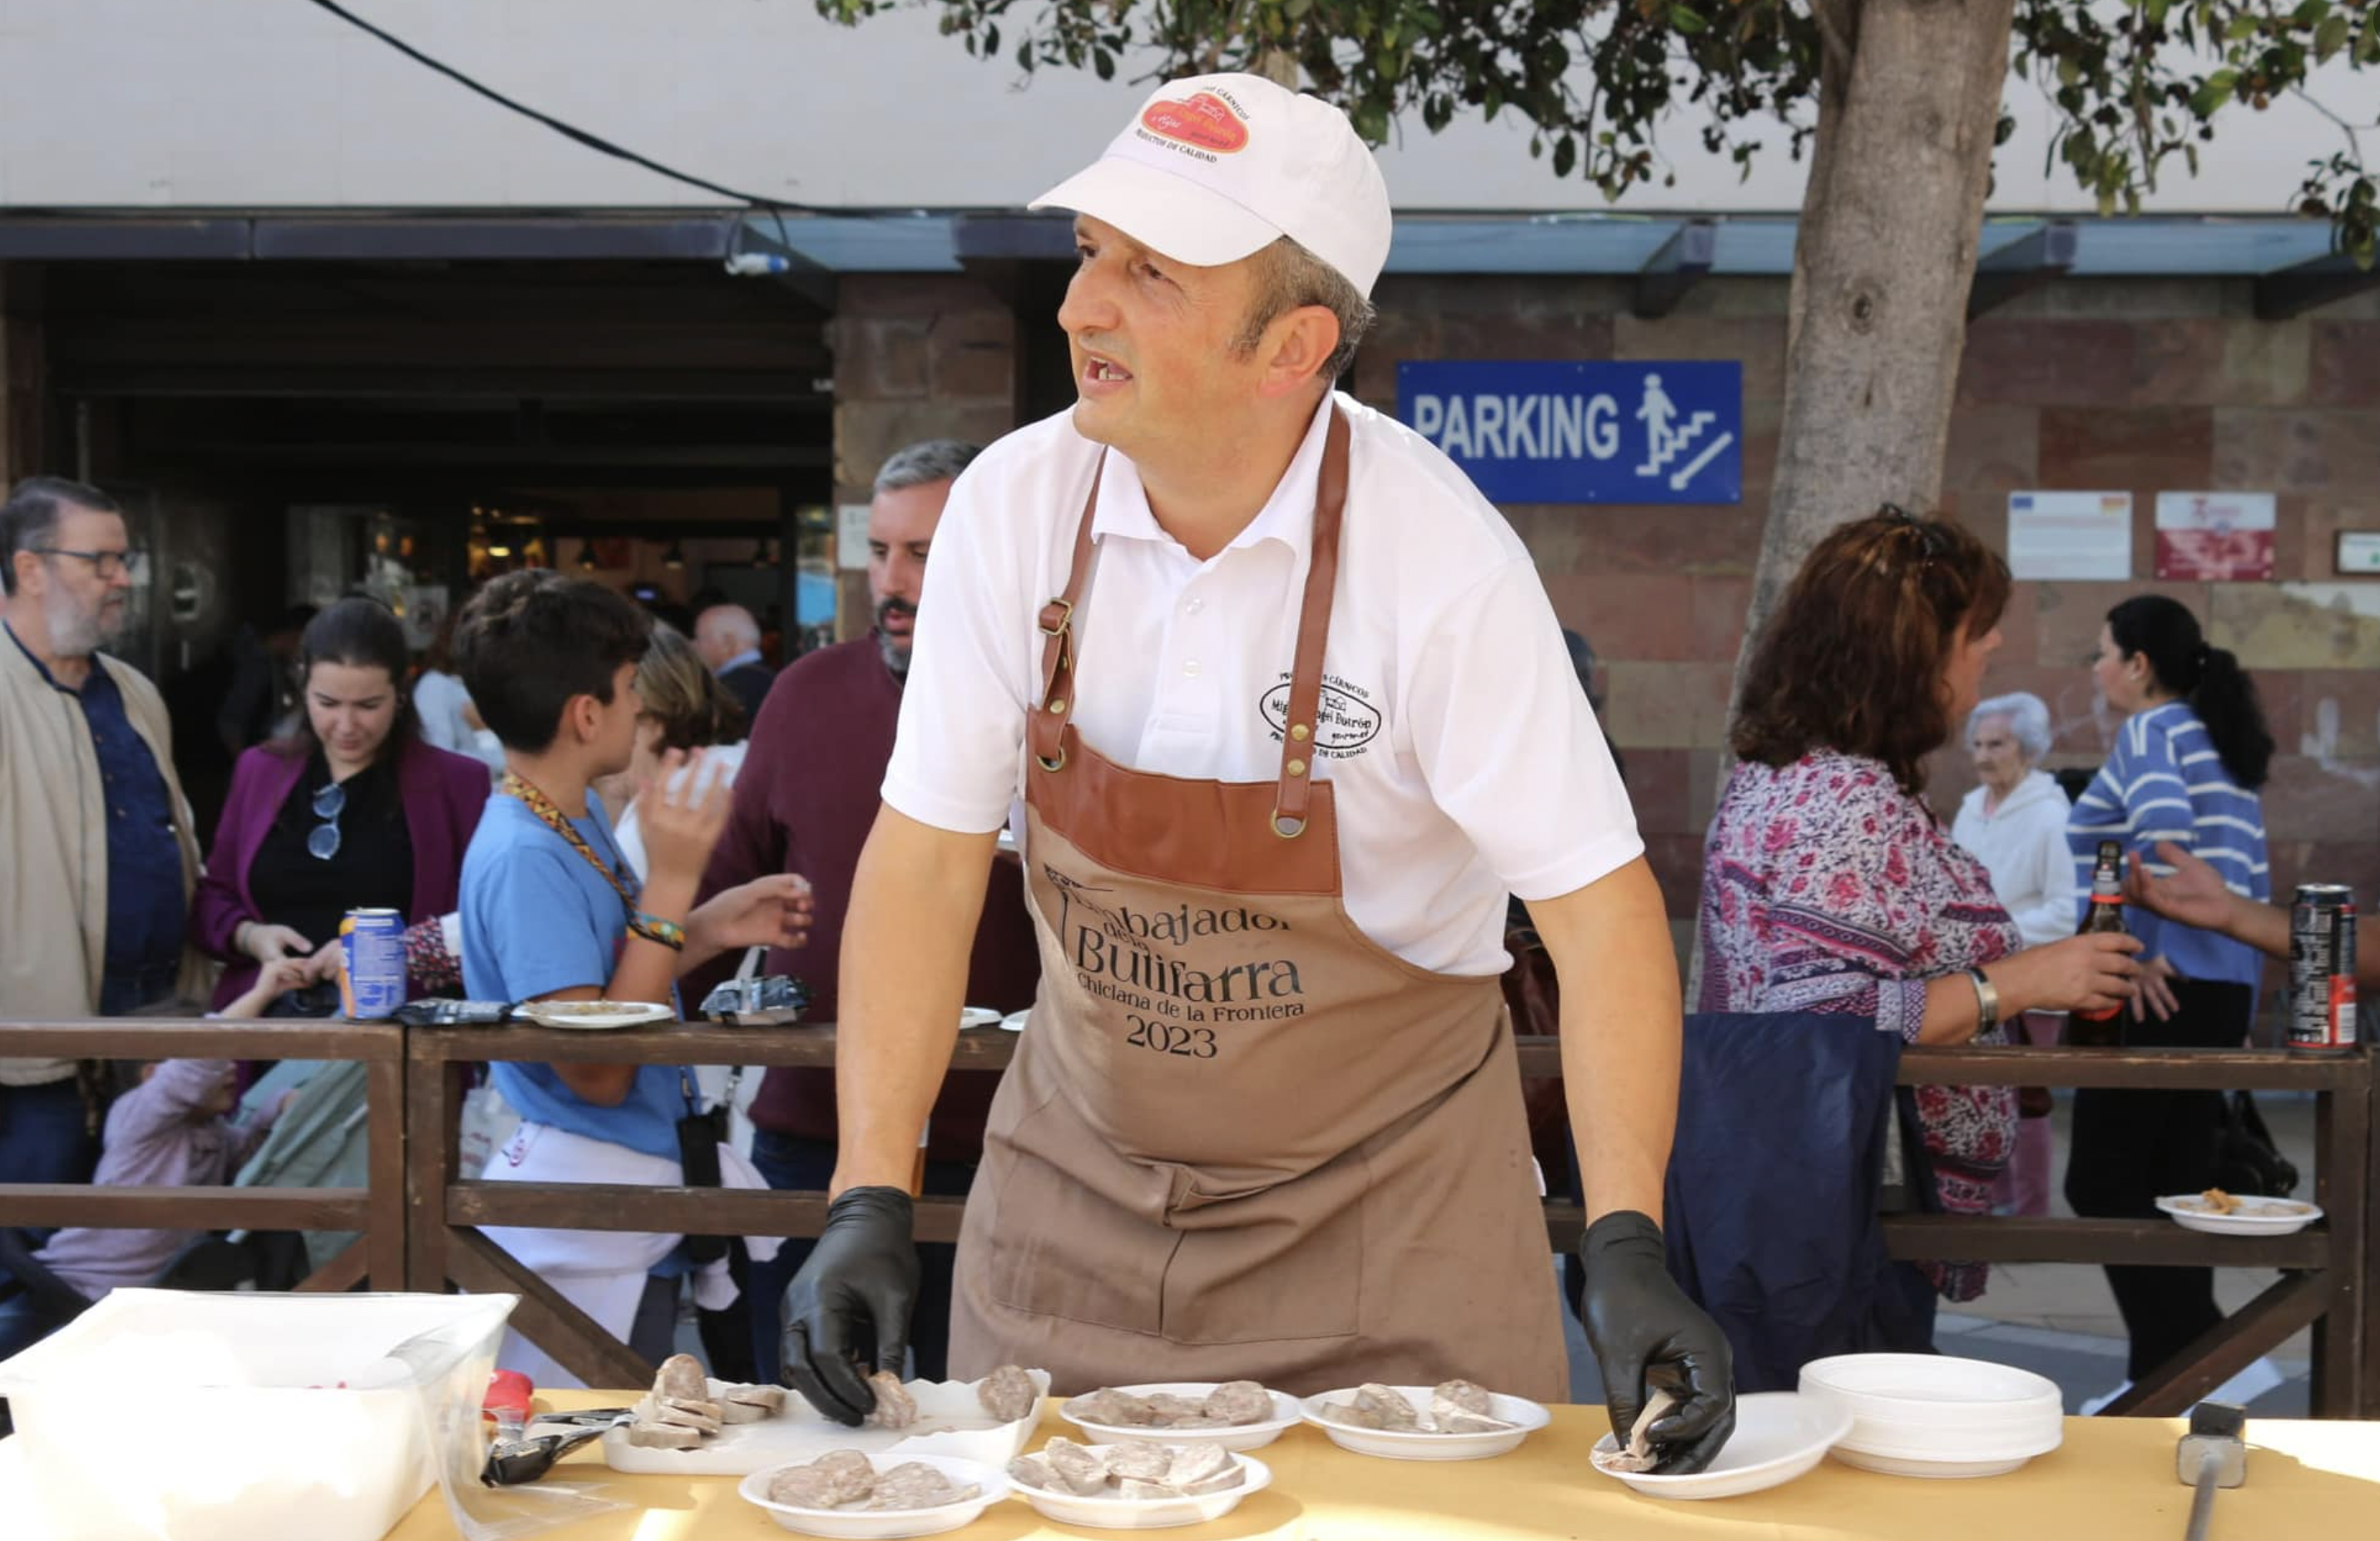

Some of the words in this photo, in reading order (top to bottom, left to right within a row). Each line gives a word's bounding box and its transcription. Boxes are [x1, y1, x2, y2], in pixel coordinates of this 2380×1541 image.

[1178, 144, 1217, 163] CALIDAD
[1415, 394, 1619, 458] PARKING
[1078, 971, 1152, 1011] Chiclana
[1157, 998, 1180, 1018] de
[1187, 1005, 1206, 1022] la
[1212, 1002, 1304, 1023] Frontera
[1126, 1014, 1218, 1058] 2023
